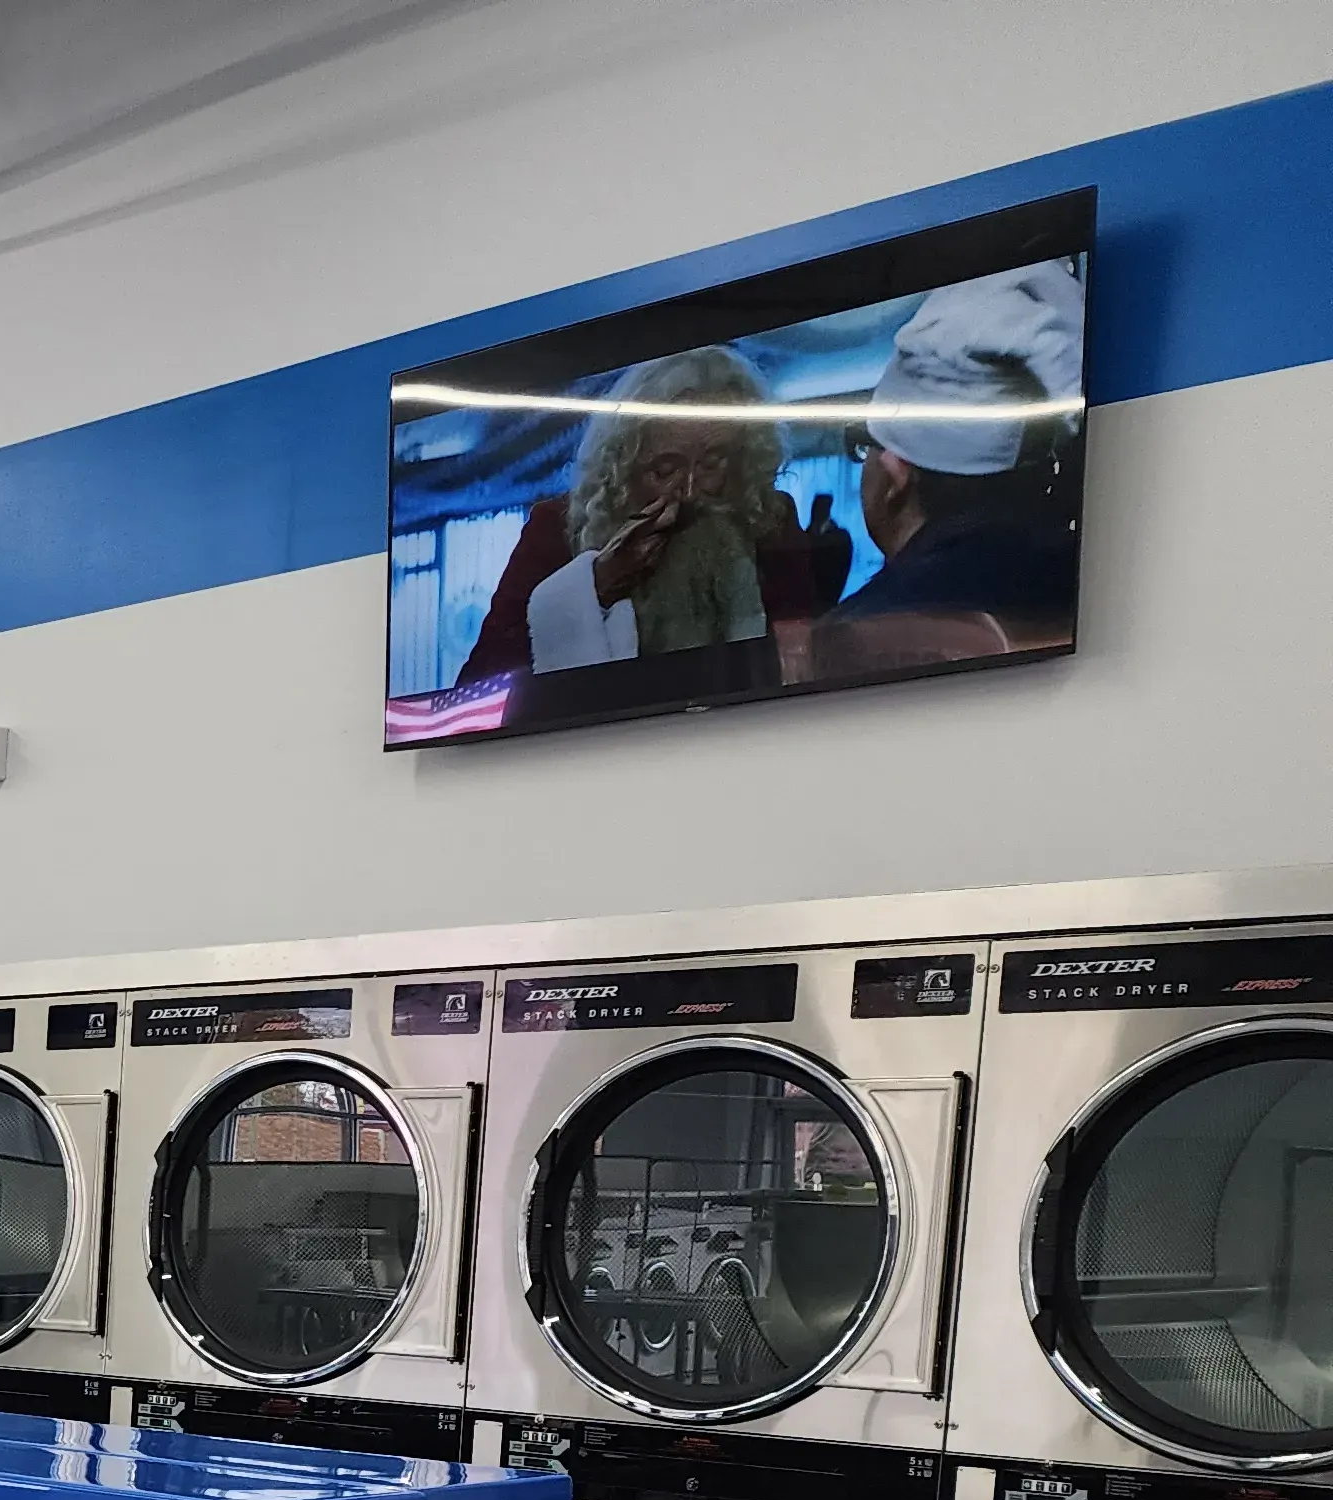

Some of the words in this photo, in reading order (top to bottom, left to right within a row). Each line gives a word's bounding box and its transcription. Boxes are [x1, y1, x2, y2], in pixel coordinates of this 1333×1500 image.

[1030, 958, 1157, 977] DEXTER
[525, 985, 619, 1002] DEXTER
[1028, 986, 1100, 1000] STACK
[1116, 983, 1190, 998] DRYER
[147, 1006, 219, 1020] DEXTER
[524, 1009, 577, 1021] STACK
[589, 1006, 644, 1018] DRYER
[146, 1026, 188, 1037] STACK
[196, 1024, 238, 1035] DRYER
